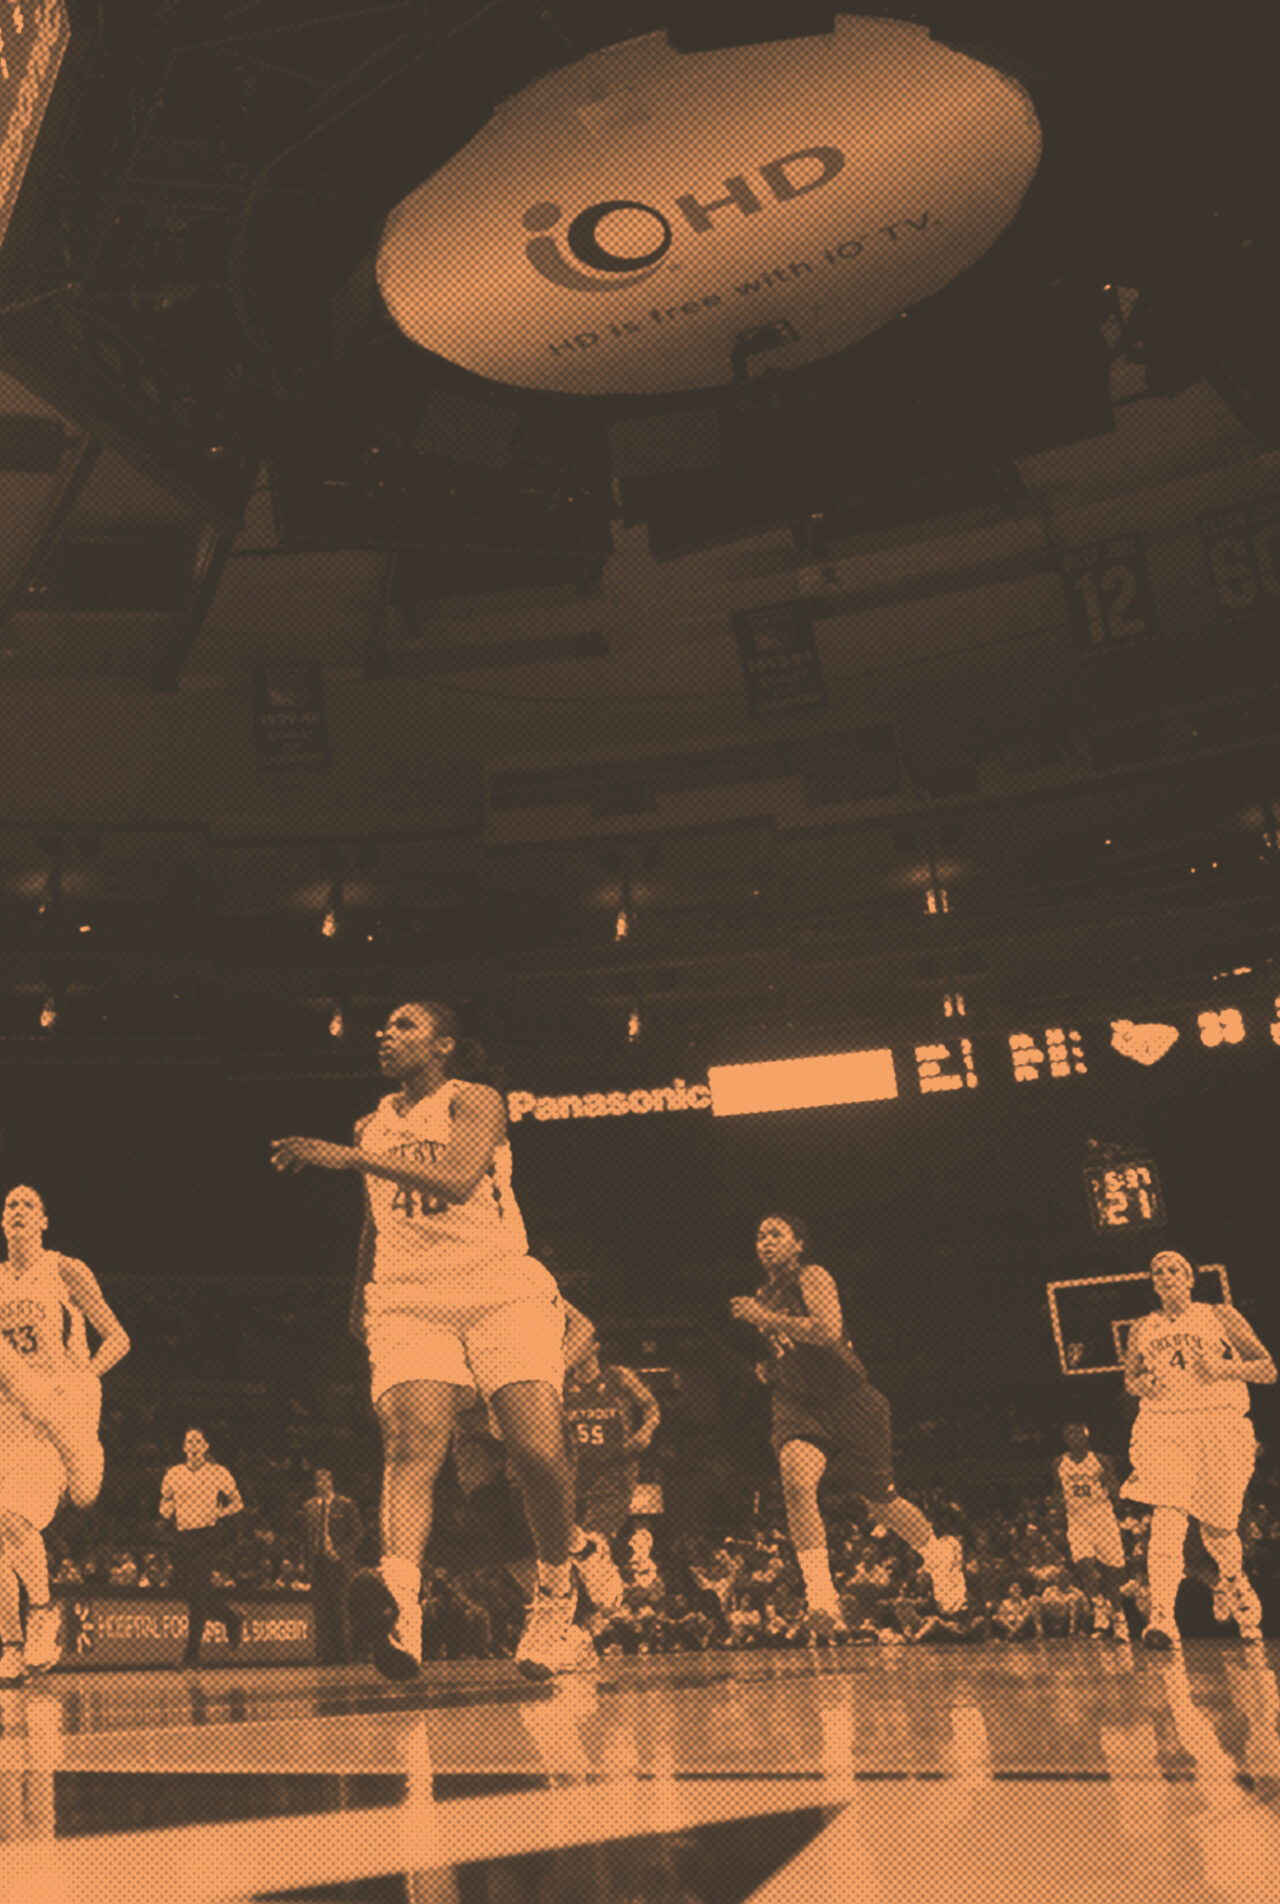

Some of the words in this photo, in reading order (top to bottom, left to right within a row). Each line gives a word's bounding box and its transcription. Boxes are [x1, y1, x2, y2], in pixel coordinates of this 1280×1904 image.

[674, 145, 846, 235] HD
[649, 293, 720, 325] free
[734, 258, 813, 298] with
[1073, 564, 1146, 643] 12
[507, 1077, 710, 1122] Panasonic
[1105, 1188, 1152, 1225] 21
[576, 1423, 605, 1446] 55
